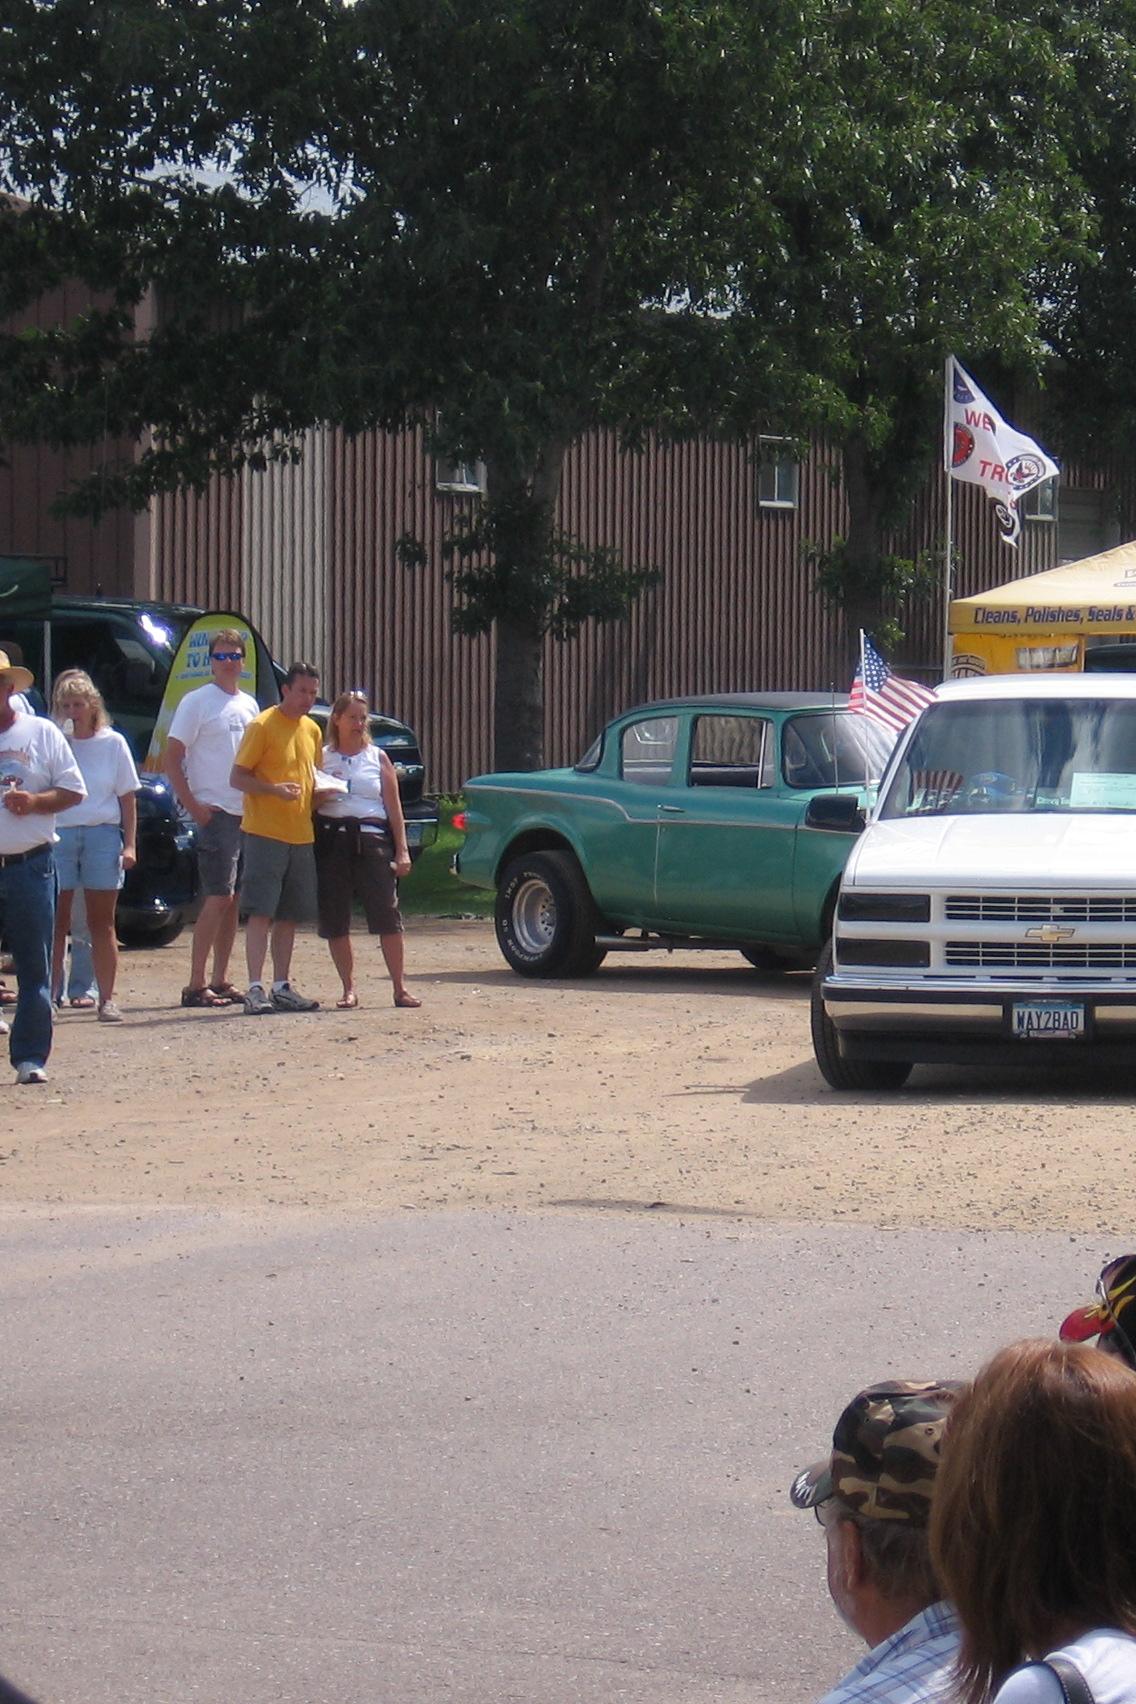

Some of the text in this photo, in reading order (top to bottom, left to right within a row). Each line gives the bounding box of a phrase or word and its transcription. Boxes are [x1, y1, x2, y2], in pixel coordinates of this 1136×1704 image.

[974, 606, 1022, 625] Cleans,
[1024, 605, 1084, 625] Polishes,
[1087, 604, 1124, 622] Seals
[1125, 604, 1136, 621] &
